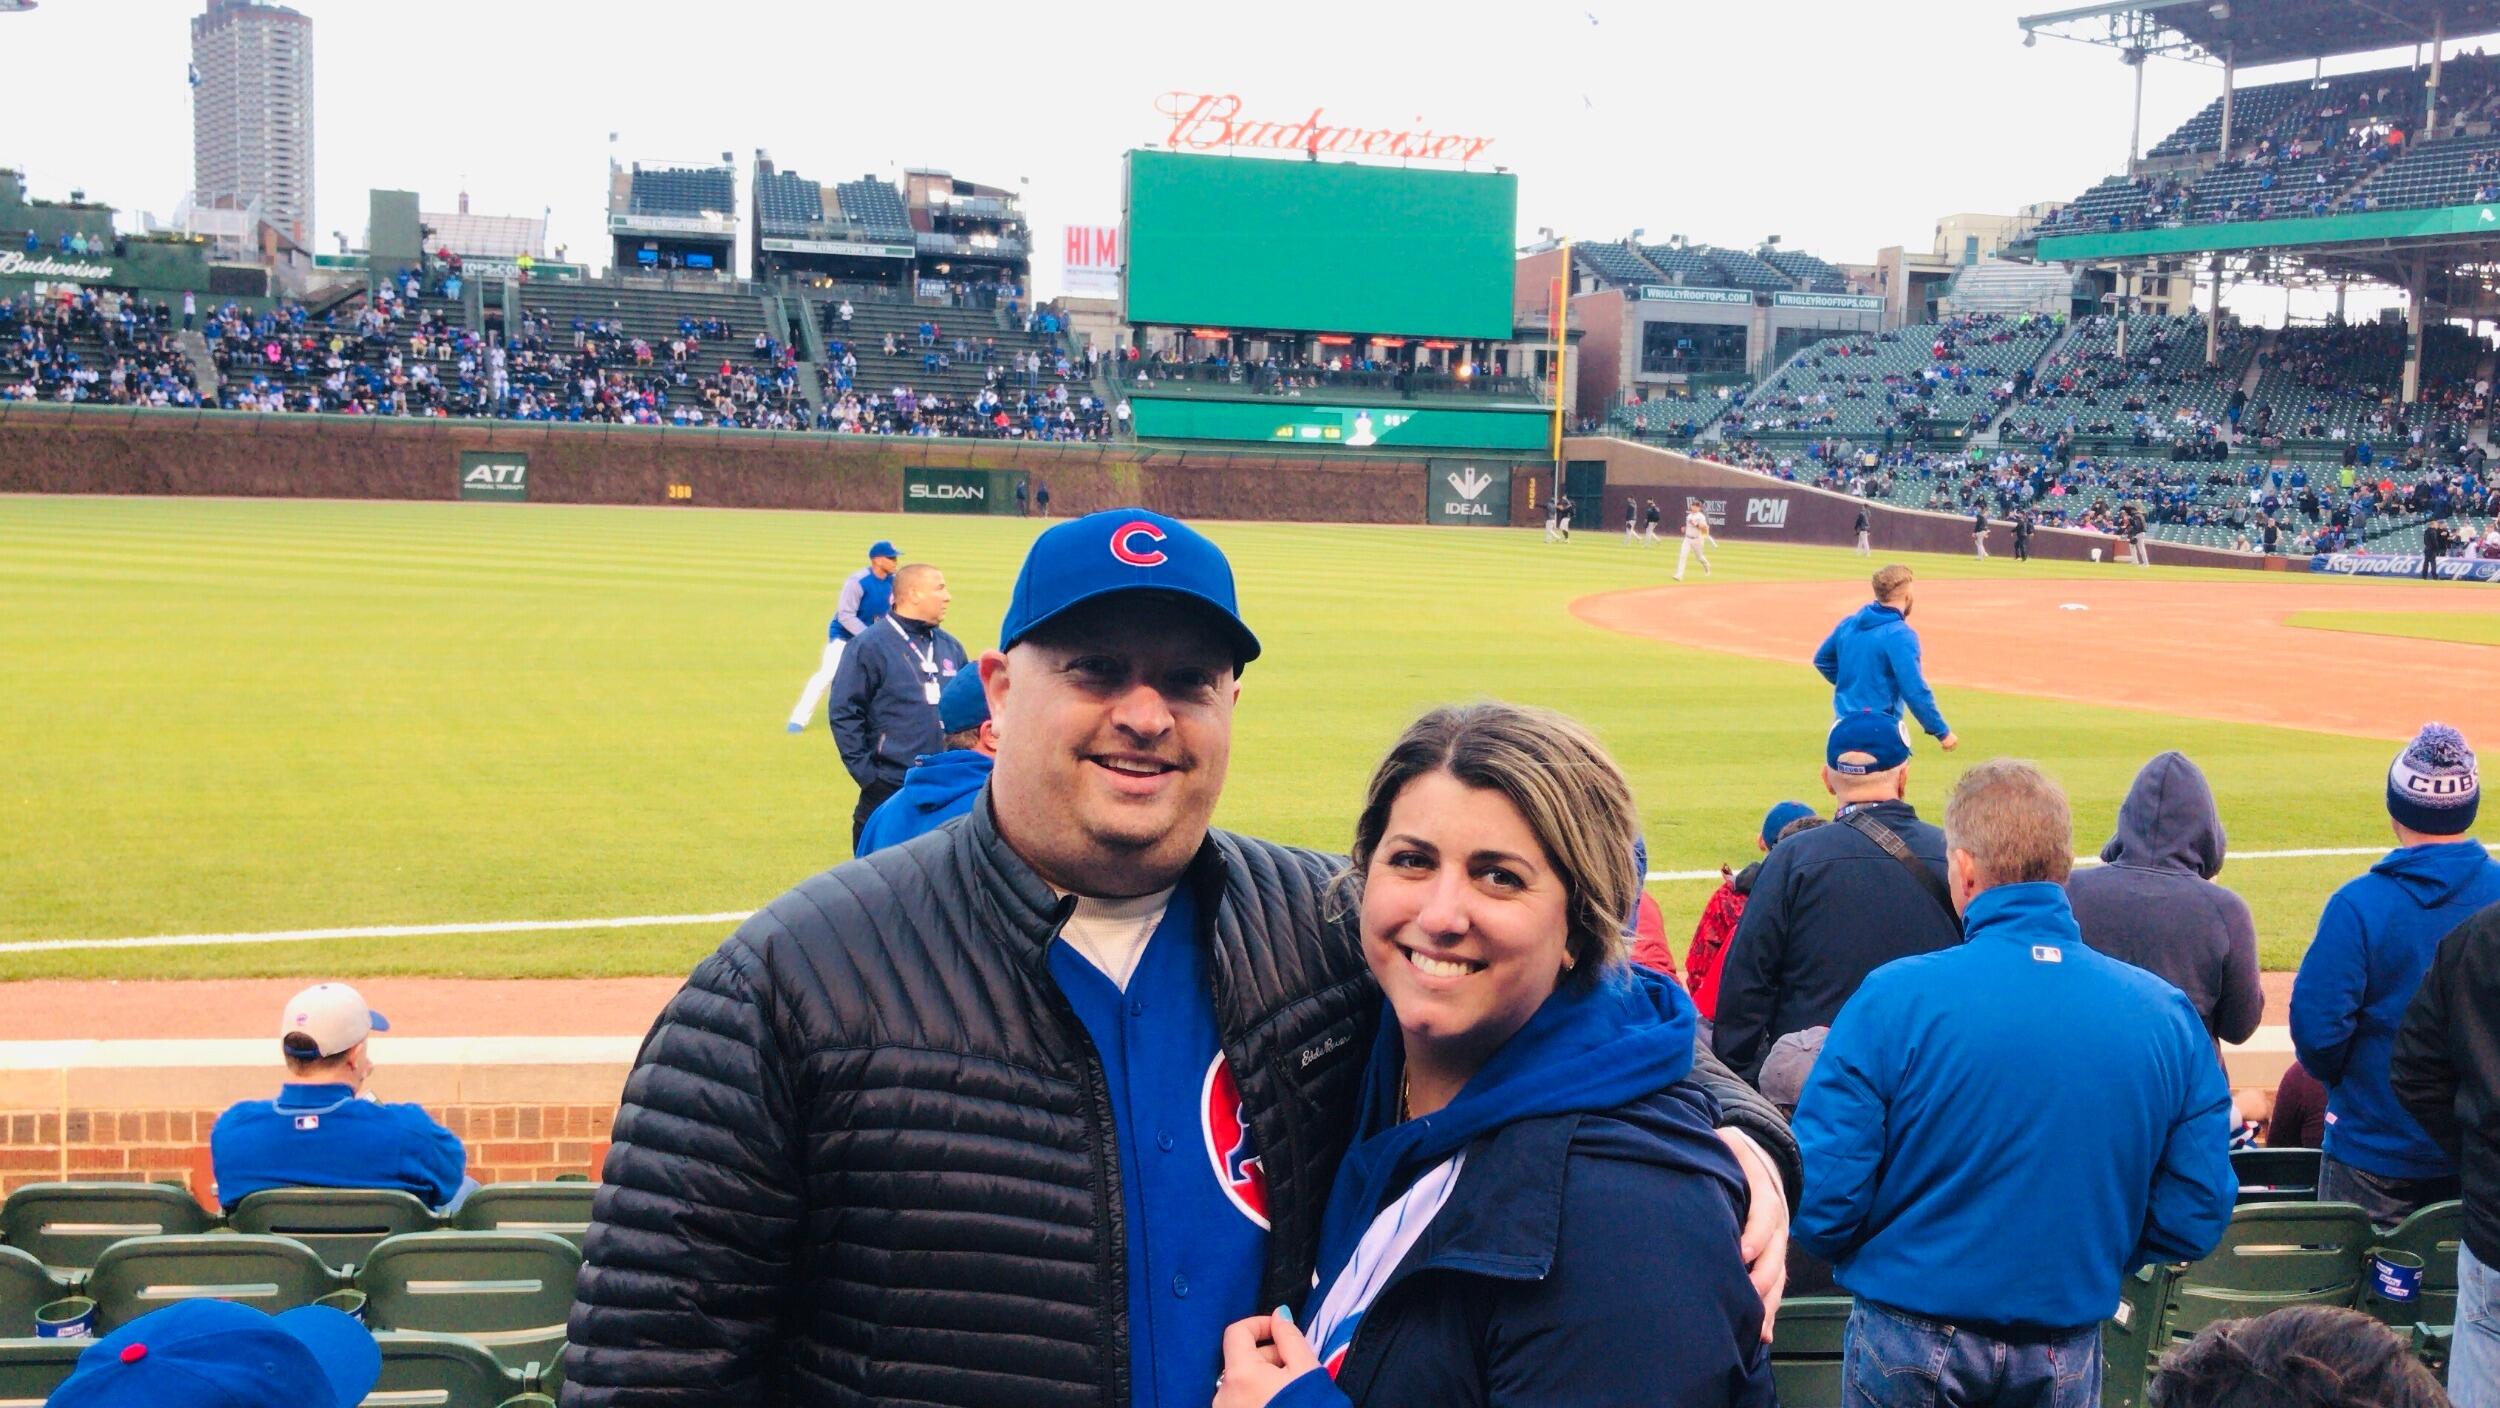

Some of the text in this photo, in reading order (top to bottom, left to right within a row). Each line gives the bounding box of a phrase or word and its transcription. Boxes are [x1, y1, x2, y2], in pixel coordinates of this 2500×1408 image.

[1154, 91, 1495, 161] Budweiser
[0, 250, 114, 278] Budweiser
[1646, 288, 1748, 303] WRIGLEYROOFTOPS.COM
[1778, 294, 1878, 308] WRIGLEYROOFTOPS.COM
[464, 464, 526, 483] ATI
[909, 483, 984, 499] SLOAN
[1445, 502, 1493, 516] IDEAL
[1746, 498, 1789, 524] PCM
[1110, 521, 1168, 567] C
[2324, 552, 2415, 576] Reynolds
